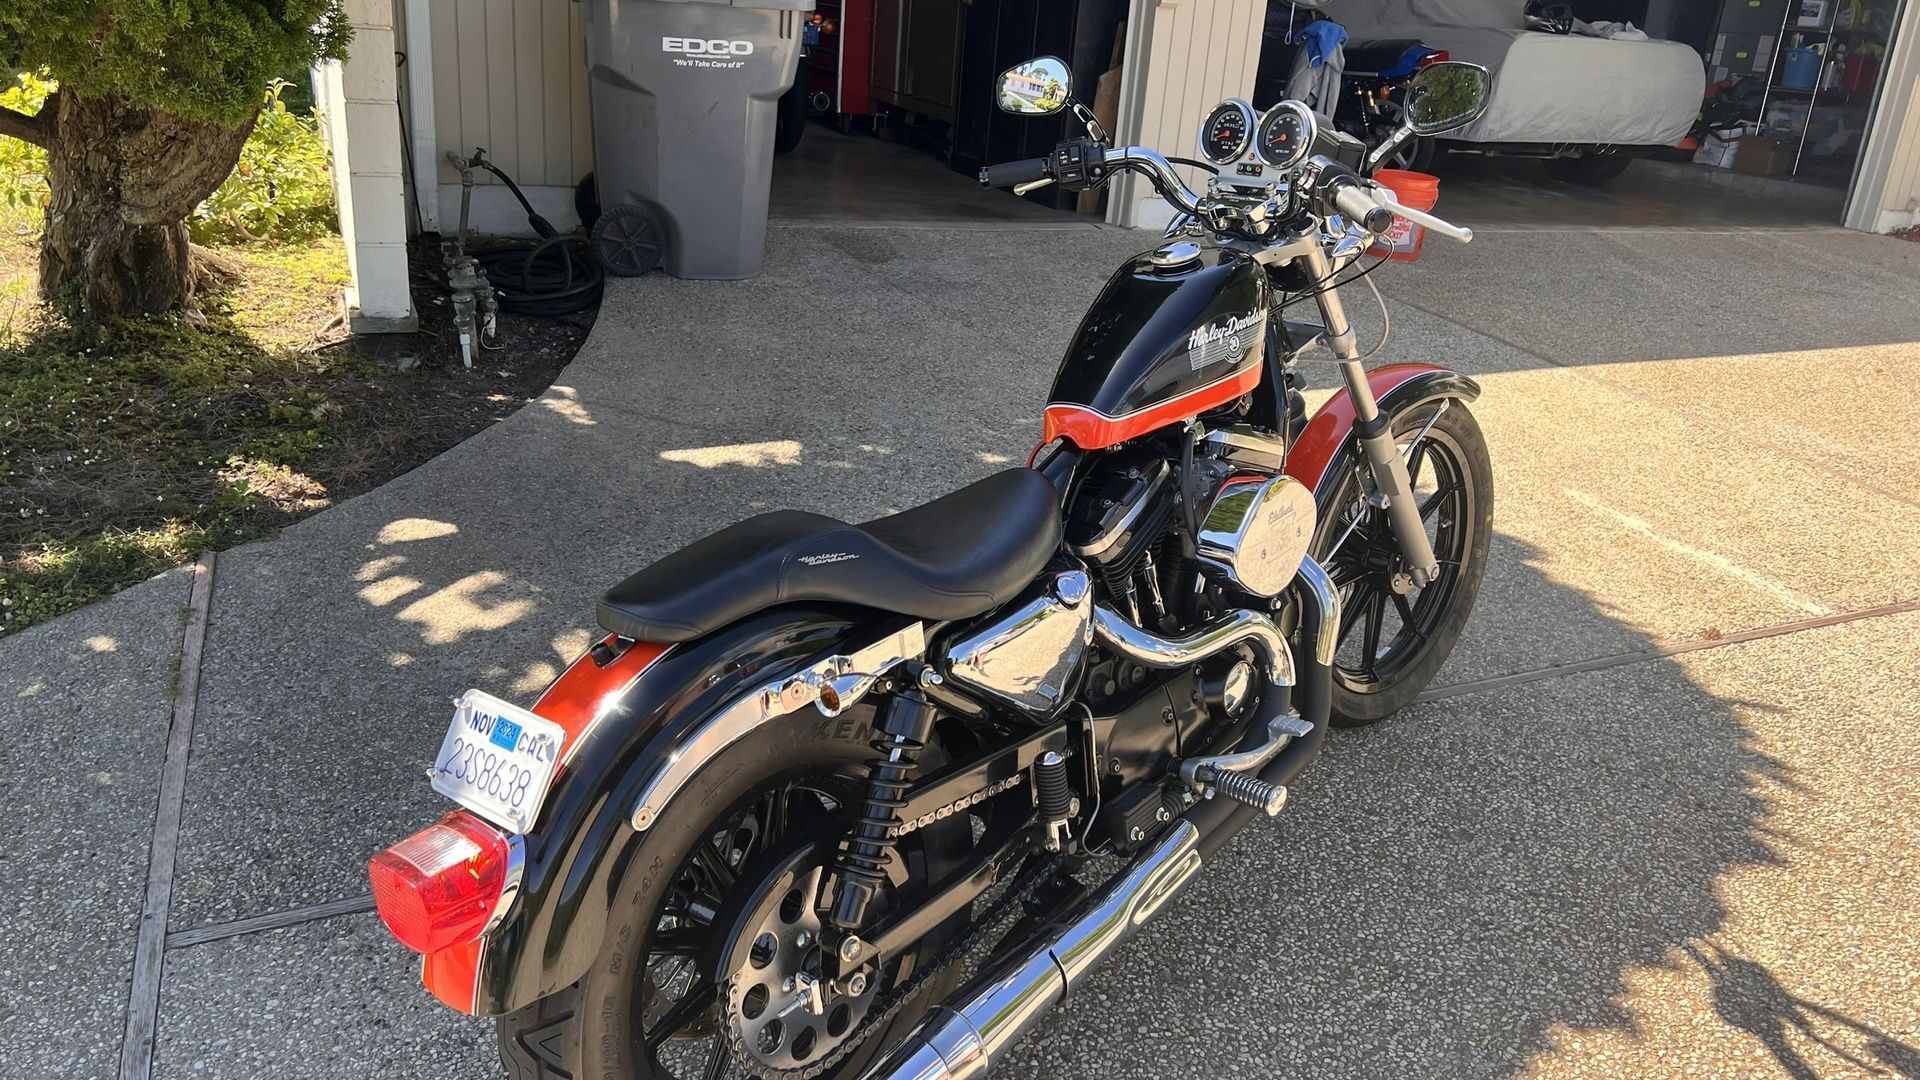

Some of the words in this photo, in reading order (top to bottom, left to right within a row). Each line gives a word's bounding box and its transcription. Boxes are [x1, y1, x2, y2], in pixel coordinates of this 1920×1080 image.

[662, 36, 754, 55] EDCO
[695, 60, 710, 68] Take
[711, 61, 728, 69] Care
[728, 61, 736, 69] of
[470, 710, 496, 736] NOV
[517, 732, 545, 762] CAL
[439, 737, 531, 807] 23S8638
